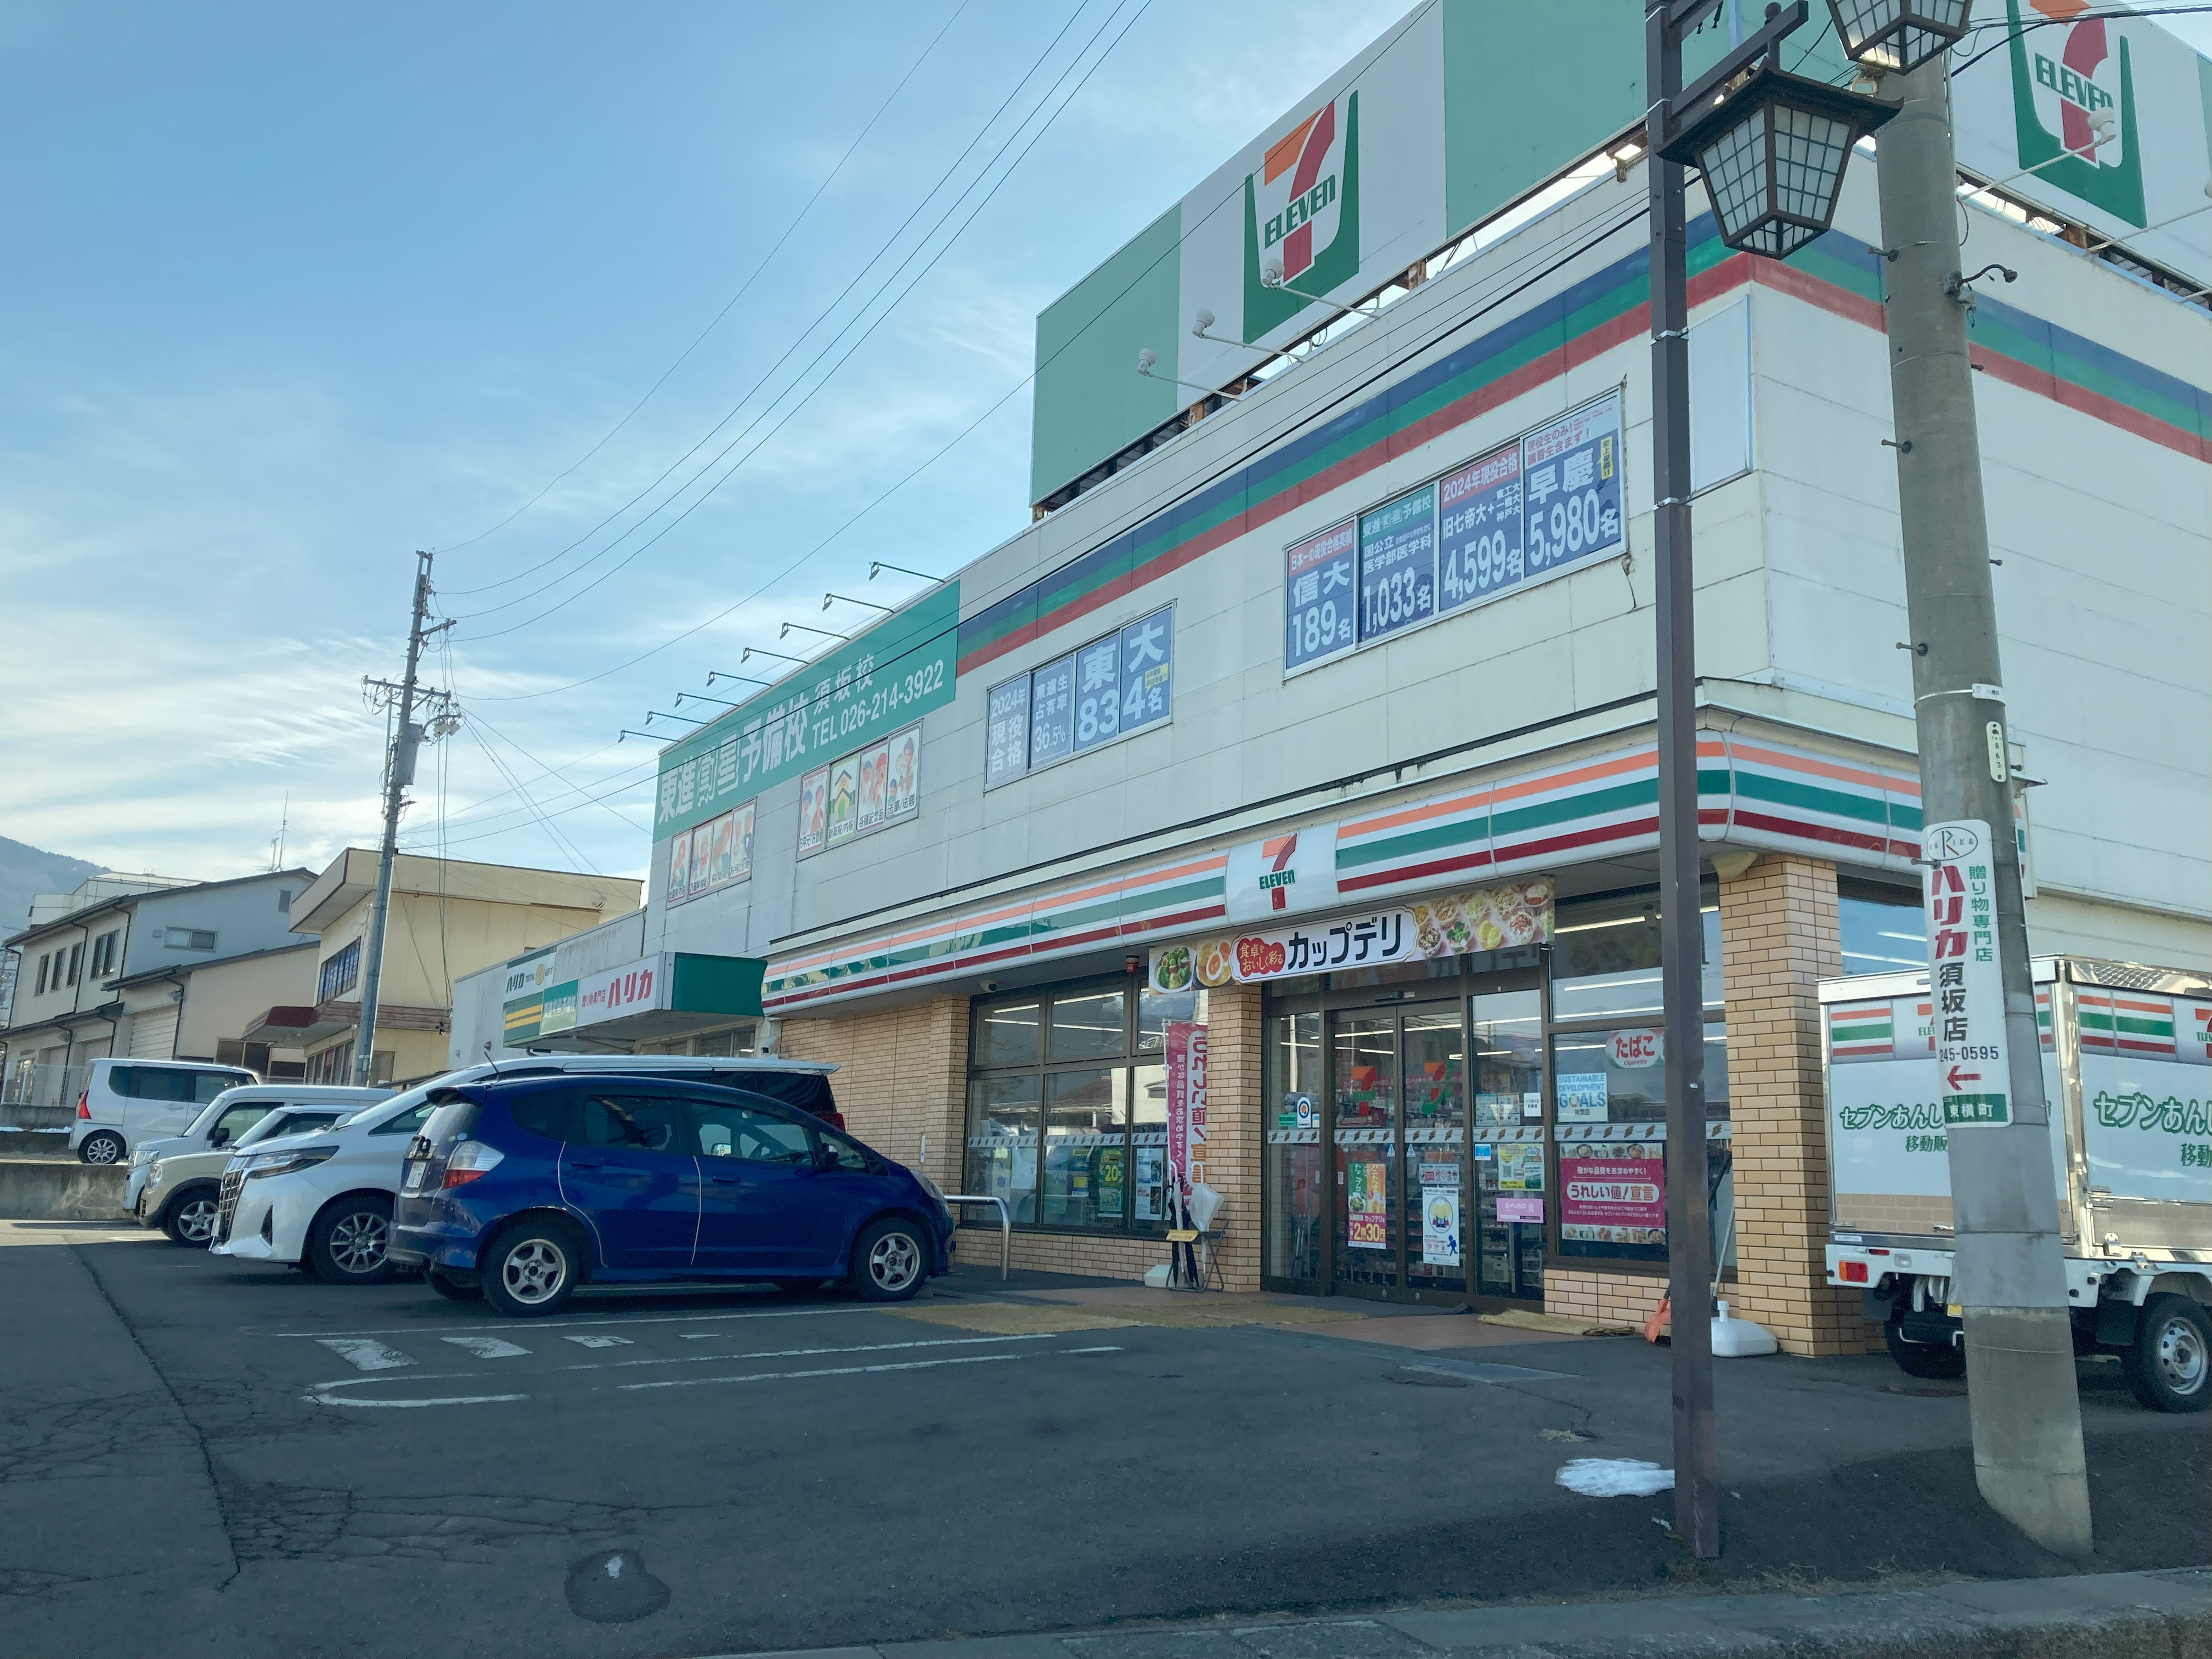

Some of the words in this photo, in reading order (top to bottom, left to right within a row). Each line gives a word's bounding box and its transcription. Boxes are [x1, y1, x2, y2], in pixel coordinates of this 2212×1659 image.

[1443, 452, 1518, 503] 2024年現役合格
[1528, 448, 1594, 504] 早慶
[1291, 528, 1353, 572] 日本一の現役合格実績
[1364, 535, 1395, 559] 国公立
[1364, 533, 1431, 575] 医学部医学科
[1293, 561, 1351, 608] 信大
[1293, 599, 1351, 657] 189名
[1082, 623, 1164, 693] 東大
[813, 654, 874, 716] 須坂校
[1035, 674, 1068, 701] 東進生
[812, 715, 838, 749] TEL
[840, 659, 944, 736] 026-214-3922
[991, 689, 1026, 719] 2024年
[1035, 693, 1067, 722] 占有率
[991, 713, 1023, 747] 現役
[1034, 722, 1066, 753] 36.5%
[657, 696, 808, 825] 東進衛星予備校
[990, 741, 1023, 774] 合格
[1931, 865, 1968, 960] ハリカ
[1969, 865, 1994, 962] 贈り物専門店
[1239, 942, 1265, 960] 食卓を
[1287, 913, 1402, 970] カップデリ
[1242, 950, 1283, 973] おいしく彩る
[506, 972, 526, 994] ハリカ
[607, 968, 653, 1009] ハリカ
[1939, 962, 1968, 1042] 須坂店
[1615, 1035, 1656, 1059] たばこ
[1623, 1058, 1648, 1066] cigarette
[1939, 1046, 1999, 1063] 245-0595
[1558, 1074, 1605, 1083] SUSTAINABLE
[1559, 1083, 1605, 1092] DEVELOPMENT
[1559, 1092, 1606, 1108] GOALS
[1104, 1165, 1119, 1182] 20
